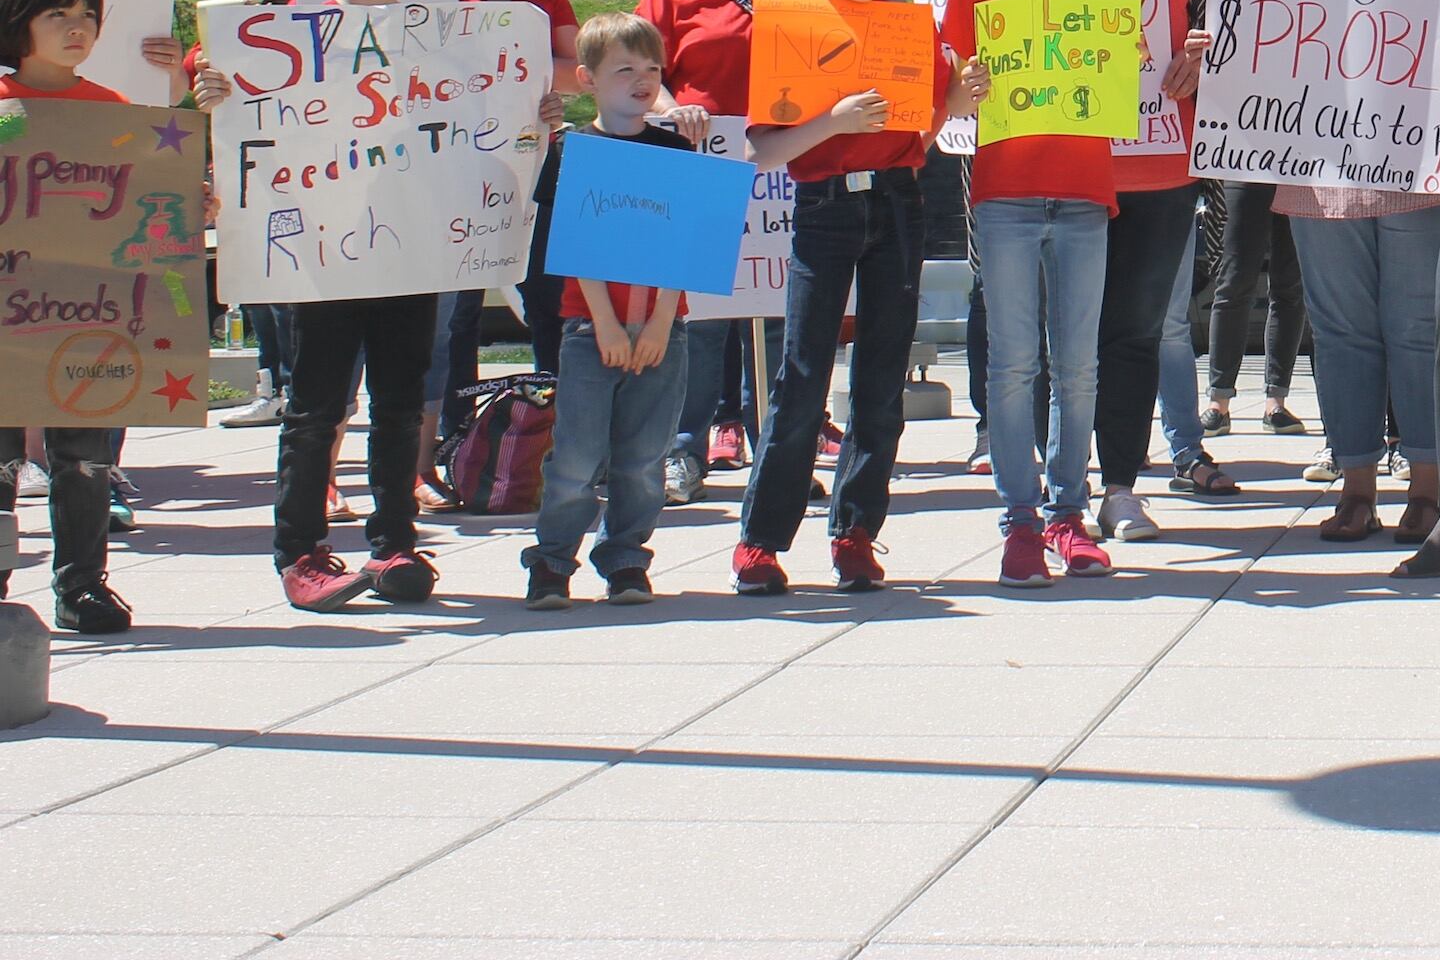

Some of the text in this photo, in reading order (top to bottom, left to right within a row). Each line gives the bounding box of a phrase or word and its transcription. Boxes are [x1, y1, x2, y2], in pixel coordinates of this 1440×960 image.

[975, 4, 1006, 41] No
[1043, 32, 1112, 74] Keep
[244, 96, 329, 131] The
[1315, 97, 1383, 141] cuts
[1390, 104, 1424, 146] to
[240, 117, 509, 209] Feeding The
[1193, 134, 1325, 179] education
[1338, 144, 1415, 192] funding
[482, 180, 515, 210] You
[267, 205, 402, 278] Rich
[449, 214, 512, 244] Should
[65, 363, 136, 380] VOUCHERS
